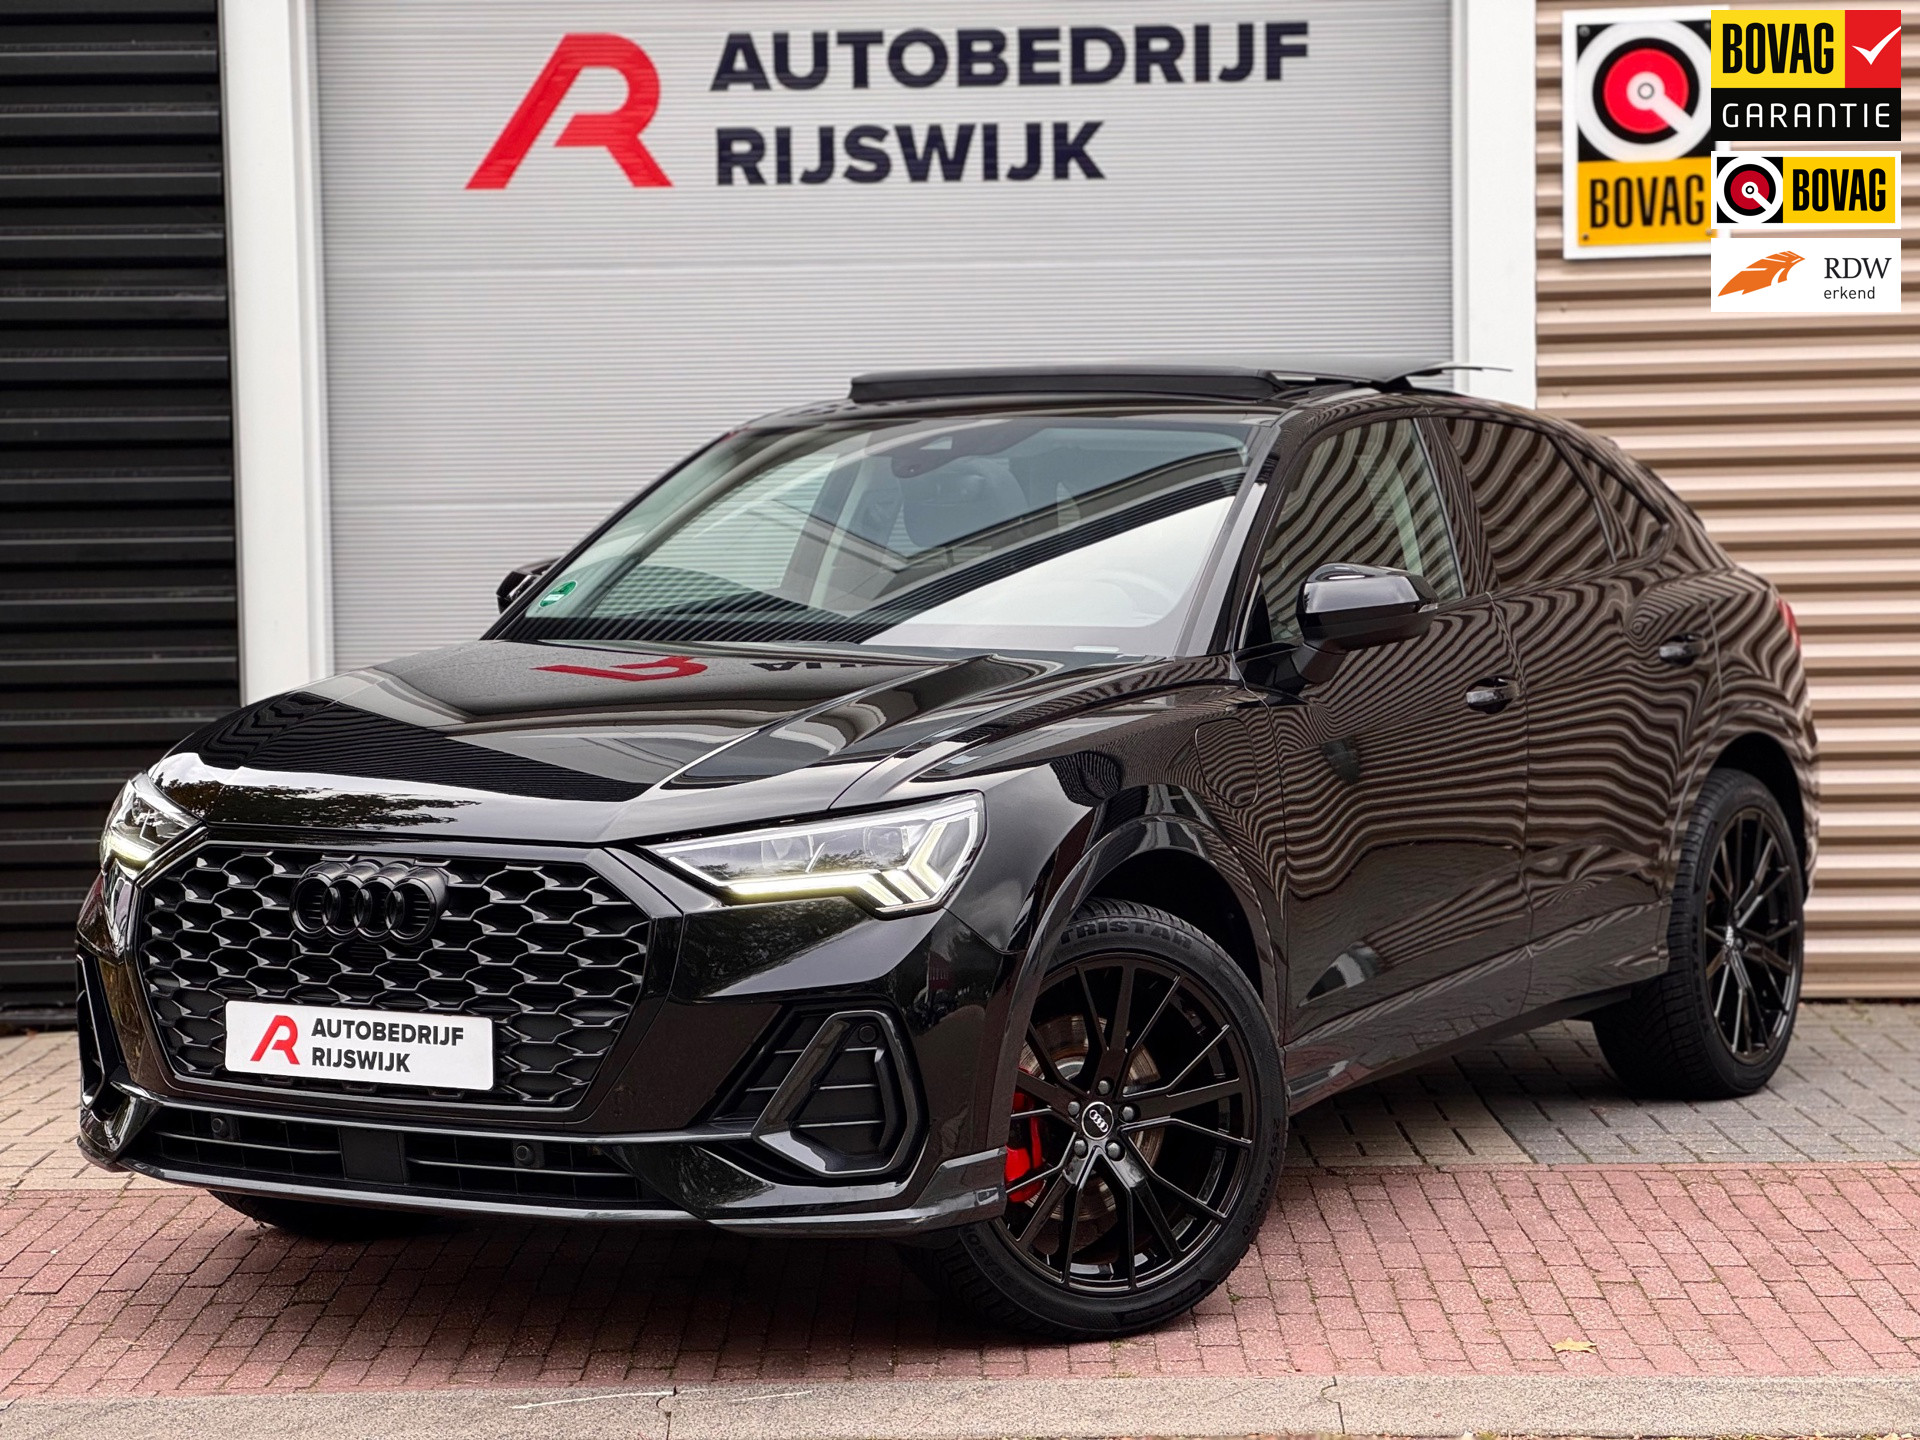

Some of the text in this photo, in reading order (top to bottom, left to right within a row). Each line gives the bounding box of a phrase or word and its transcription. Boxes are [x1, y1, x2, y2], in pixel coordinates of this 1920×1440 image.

[710, 22, 1310, 92] AUTOBEDRIJF
[715, 121, 1107, 187] RIJSWIJK
[1588, 174, 1705, 229] BOVAG
[1060, 920, 1193, 949] TRISTAR
[311, 1018, 464, 1046] AUTOBEDRIJF
[311, 1047, 411, 1073] RIJSWIJK
